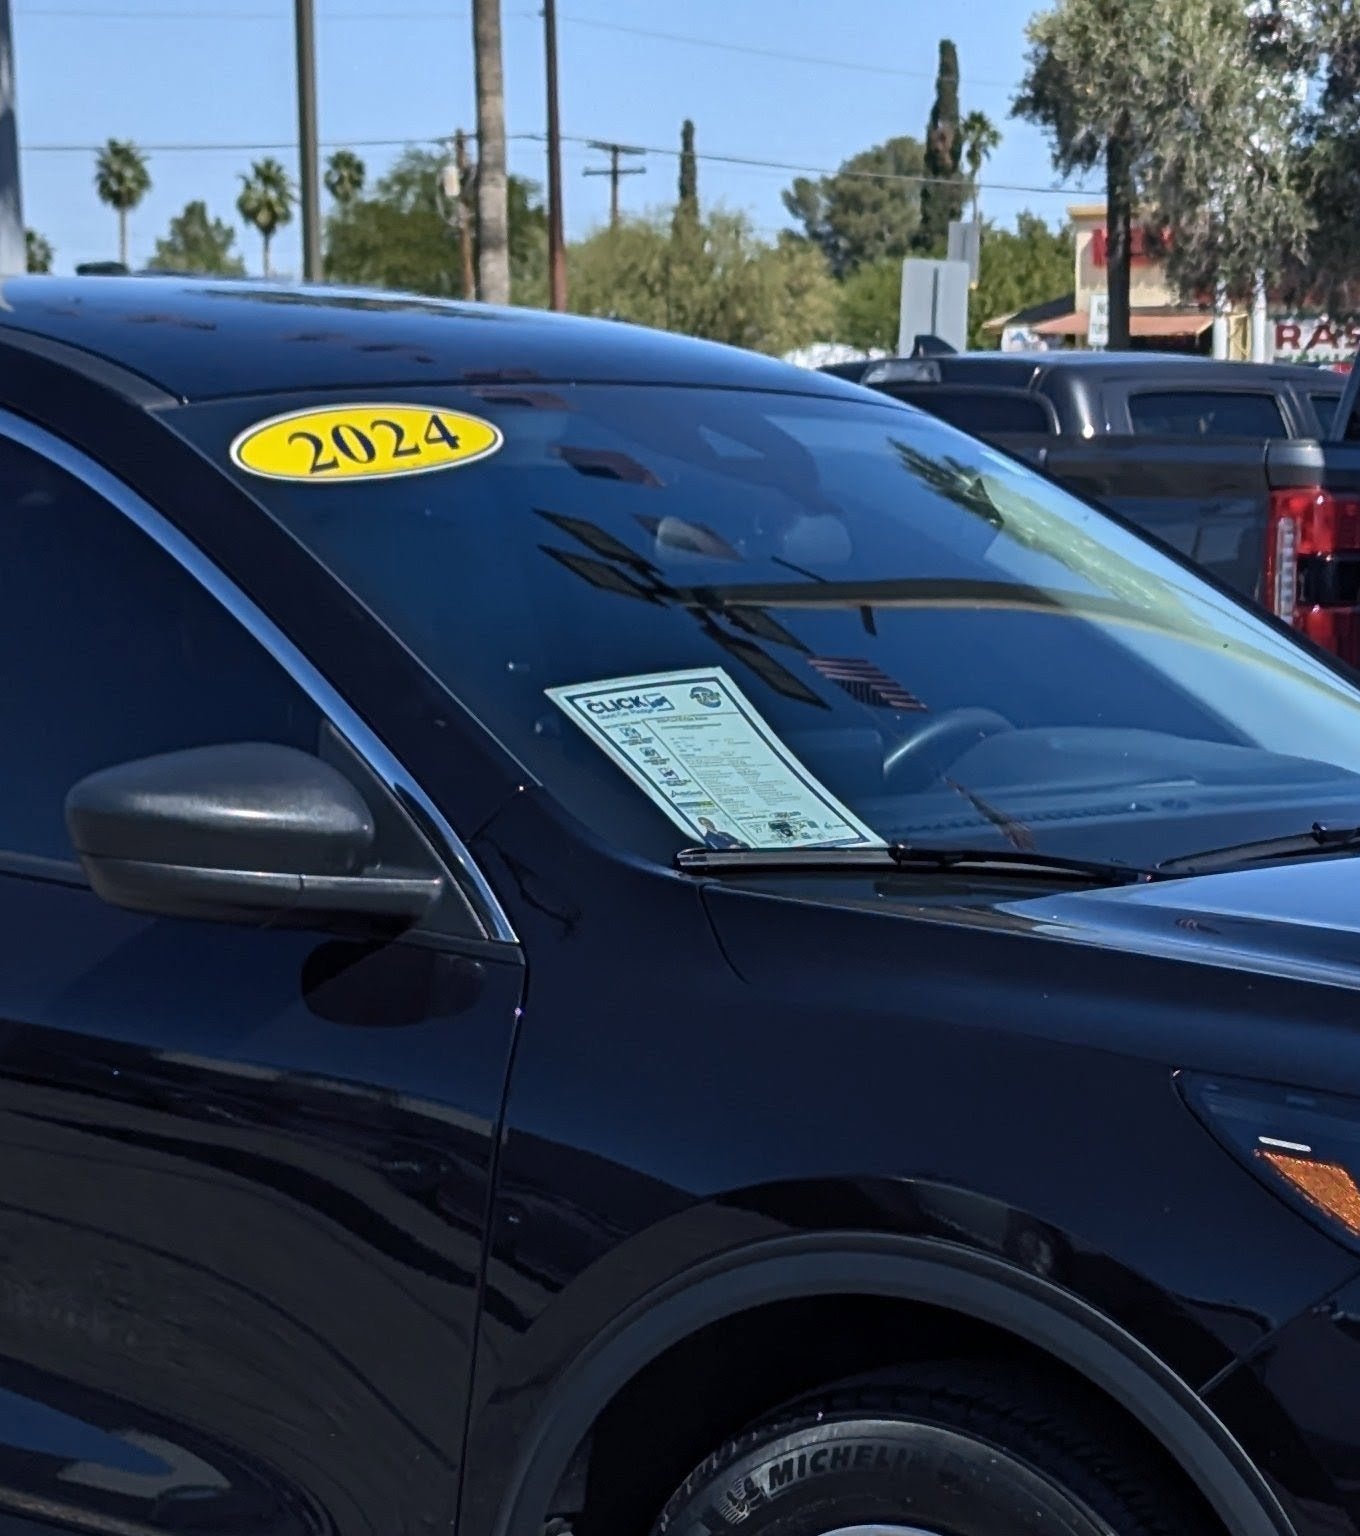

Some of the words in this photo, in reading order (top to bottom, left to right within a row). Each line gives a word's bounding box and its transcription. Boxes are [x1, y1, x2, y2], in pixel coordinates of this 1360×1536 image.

[287, 413, 460, 474] 2024
[586, 695, 649, 714] CLICK
[768, 1444, 933, 1493] MICHELIN
